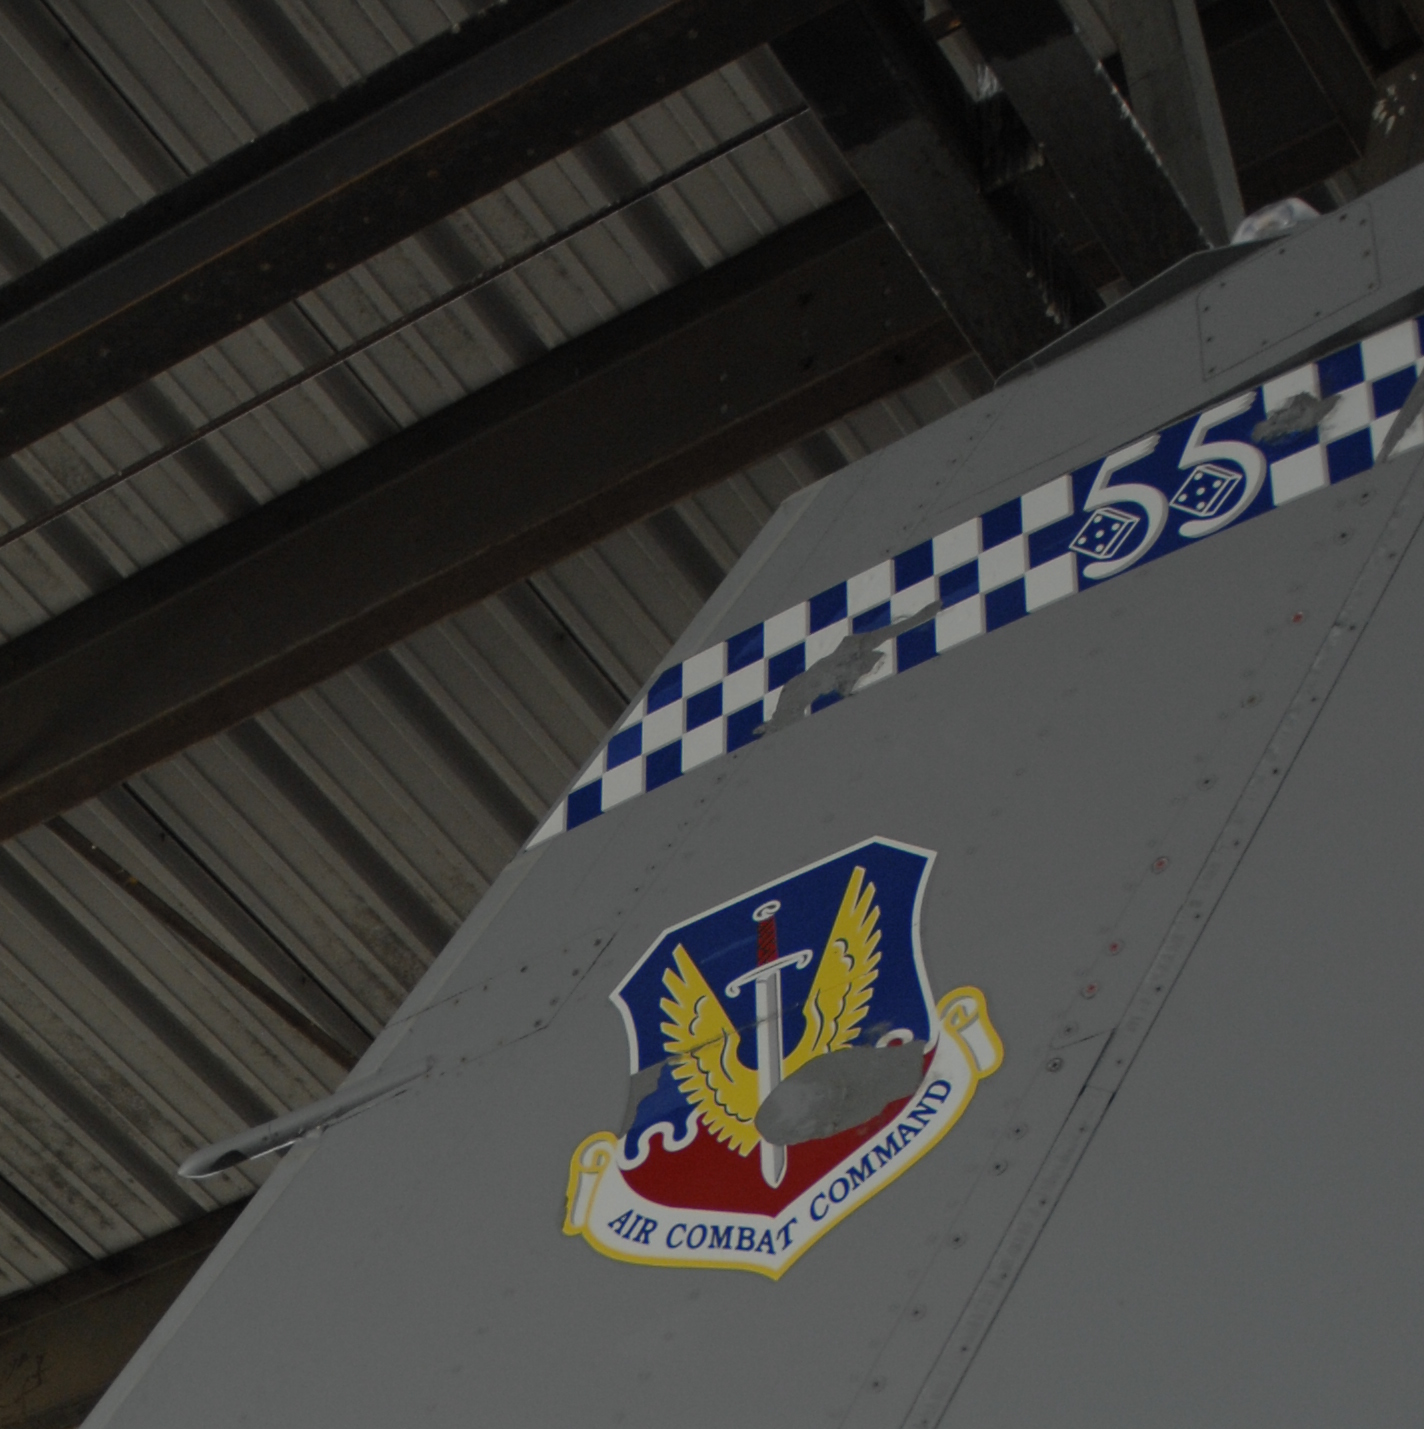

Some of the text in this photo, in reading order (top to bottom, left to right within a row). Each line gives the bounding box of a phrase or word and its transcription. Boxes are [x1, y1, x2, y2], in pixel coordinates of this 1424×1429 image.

[1082, 390, 1267, 580] 55
[607, 1078, 953, 1256] AIR COMBAT COMMAND
